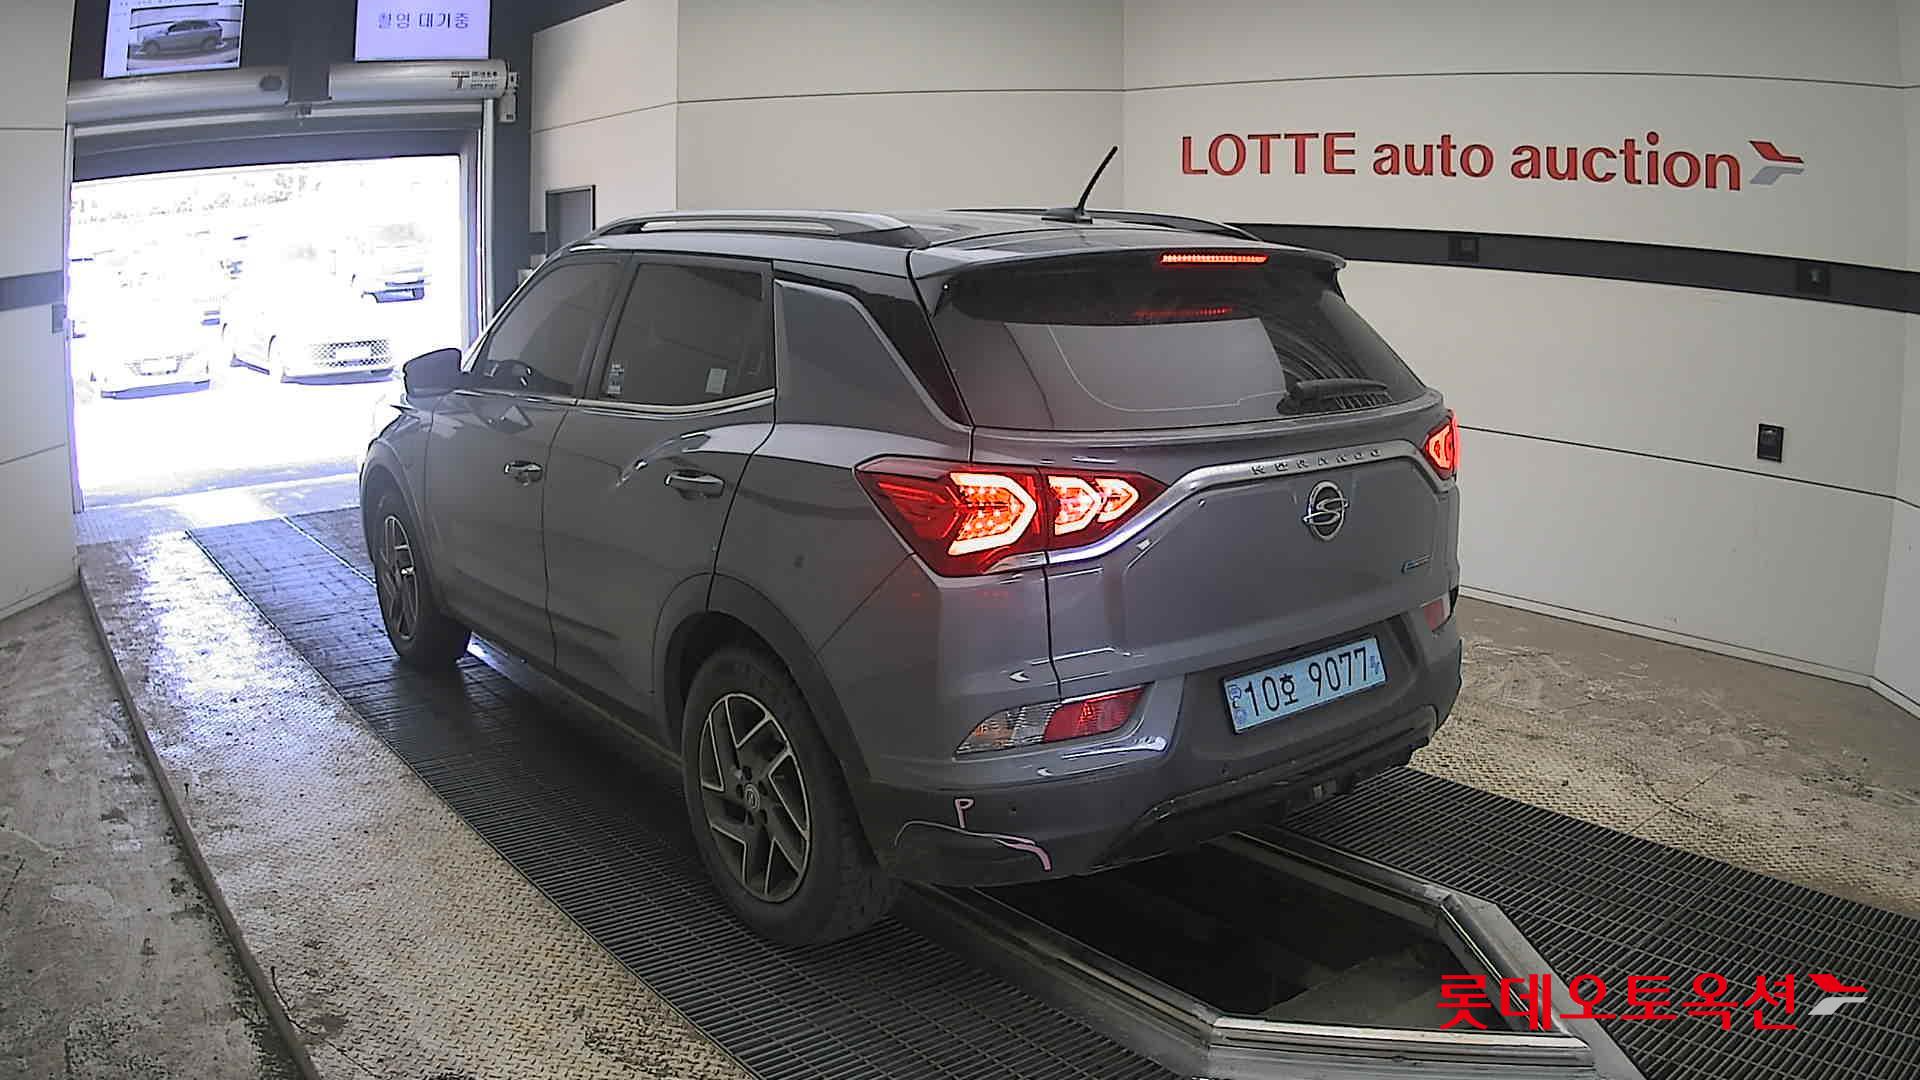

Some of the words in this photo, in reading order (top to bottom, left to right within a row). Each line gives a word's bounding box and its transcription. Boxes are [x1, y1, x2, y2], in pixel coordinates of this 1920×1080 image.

[1182, 132, 1357, 176] LOTTE
[1373, 134, 1494, 177] auto
[1511, 132, 1742, 191] auction
[1245, 673, 1298, 716] 10호
[1308, 647, 1367, 696] 9077
[954, 798, 975, 828] P
